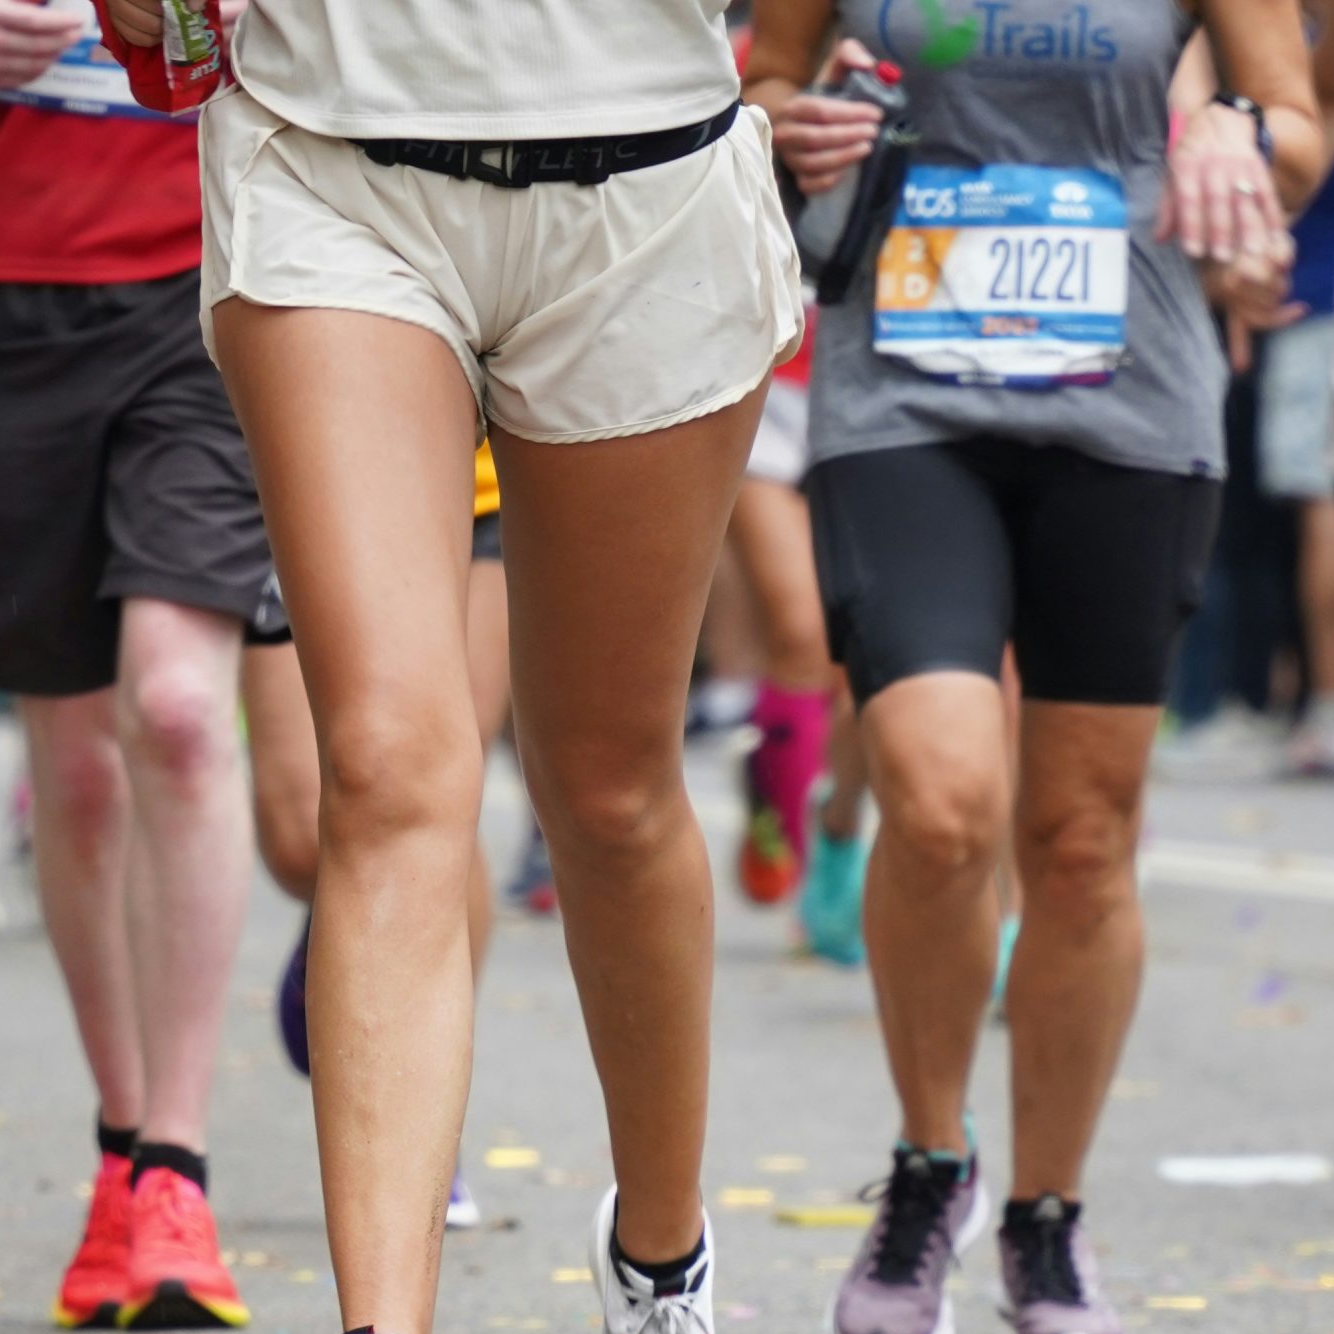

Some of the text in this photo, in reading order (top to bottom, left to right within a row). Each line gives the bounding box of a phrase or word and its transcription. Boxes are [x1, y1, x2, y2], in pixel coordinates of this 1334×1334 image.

[973, 2, 1118, 62] Trails
[903, 184, 956, 218] tcs
[988, 237, 1091, 300] 21221
